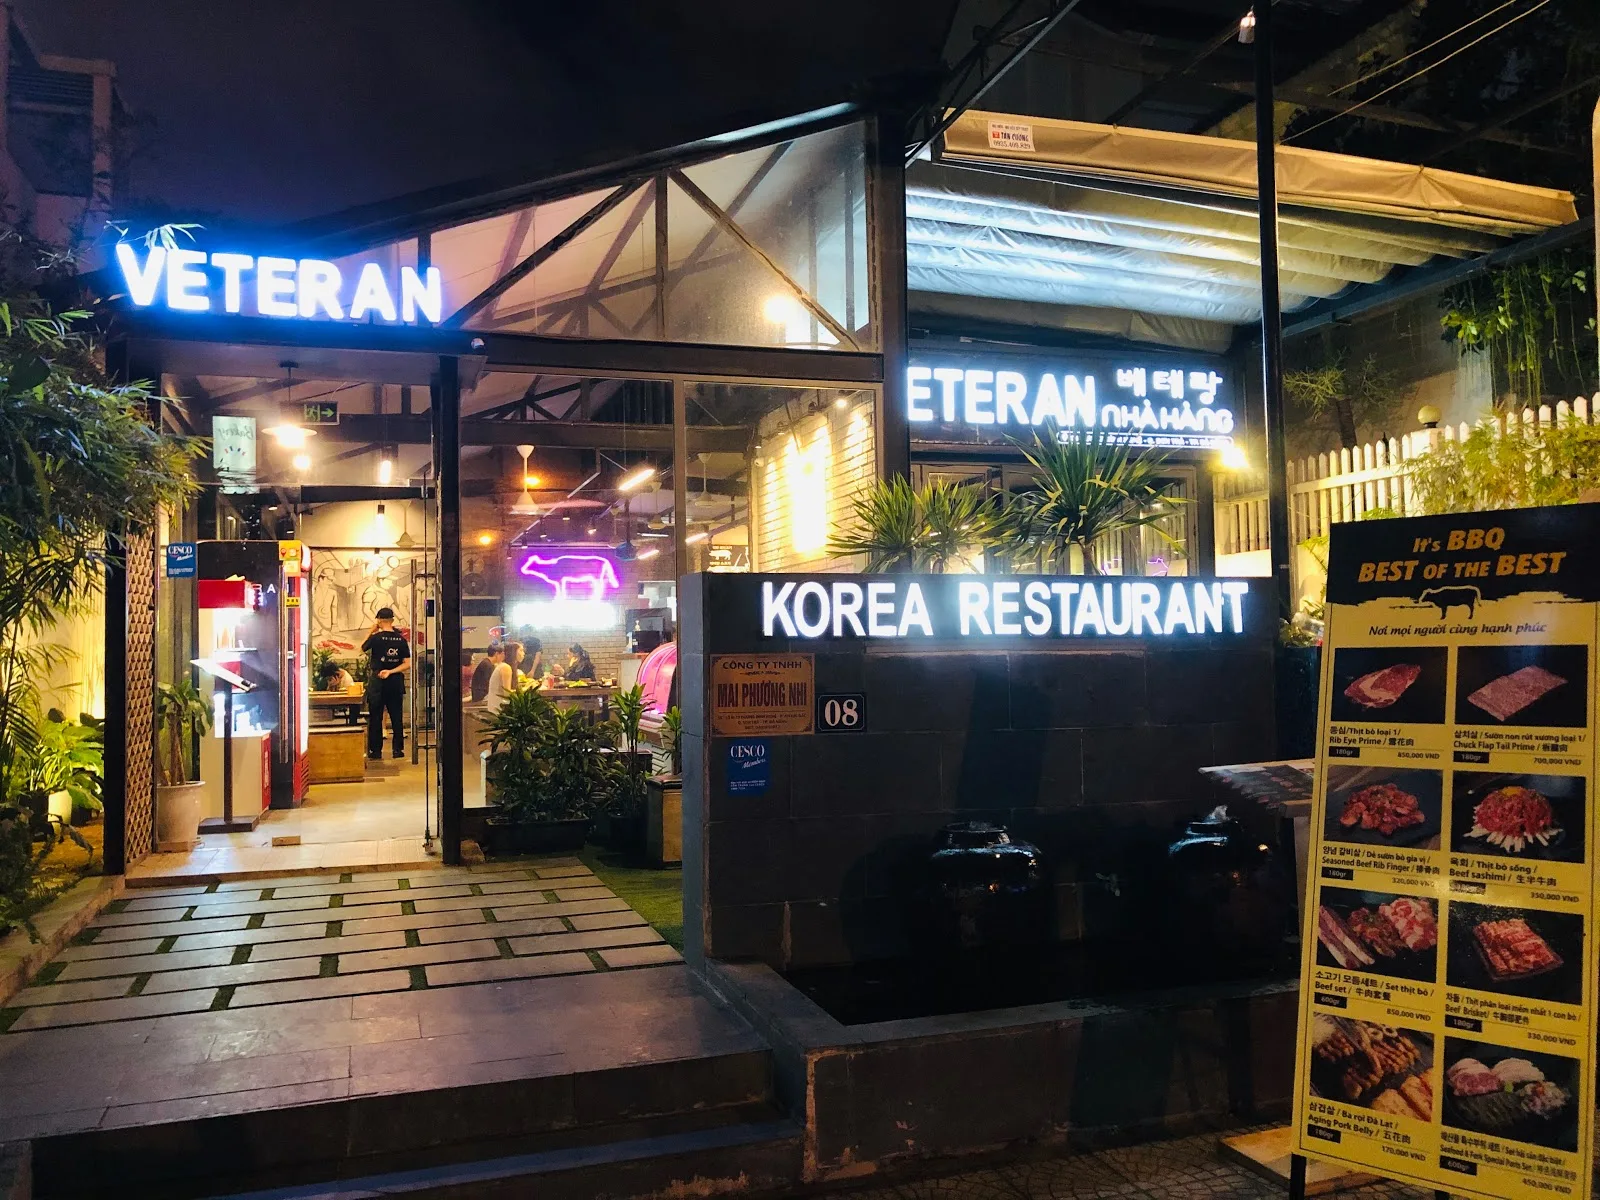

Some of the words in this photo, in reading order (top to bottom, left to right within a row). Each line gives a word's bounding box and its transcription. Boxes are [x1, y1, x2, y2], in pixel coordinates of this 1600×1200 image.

[115, 244, 441, 323] VETERAN
[906, 366, 1096, 426] ETERAN
[1413, 537, 1441, 553] It's
[1447, 527, 1505, 551] BBQ
[1358, 559, 1419, 583] BEST
[1423, 564, 1448, 580] OF
[1453, 561, 1490, 578] THE
[1496, 551, 1567, 576] BEST
[761, 581, 934, 638] KOREA
[958, 581, 1249, 636] RESTAURANT
[1369, 625, 1387, 636] Nơi
[1390, 626, 1412, 637] mọi
[1414, 624, 1447, 637] người
[1449, 625, 1478, 637] cùng
[1481, 623, 1512, 635] hạnh
[723, 660, 753, 670] CÔNG
[757, 661, 769, 669] TY
[772, 661, 802, 669] TNHH
[717, 683, 738, 708] MAI
[789, 682, 807, 706] NHI
[824, 699, 859, 727] 08
[1329, 736, 1341, 744] Rib
[1343, 736, 1356, 745] Eye
[1360, 737, 1382, 745] Prime
[1453, 741, 1476, 749] Chuck
[1478, 742, 1494, 750] Flap
[1512, 743, 1535, 751] Prime
[730, 744, 765, 758] CESCO
[1322, 857, 1354, 866] Seasoned
[1356, 858, 1372, 868] Beef
[1373, 860, 1385, 869] Rib
[1387, 862, 1409, 873] Finger
[1449, 868, 1470, 877] Beef
[1471, 870, 1506, 881] sashimi
[1562, 894, 1580, 903] VND
[1315, 971, 1341, 982] 소고기
[1385, 983, 1399, 991] Set
[1315, 981, 1333, 990] Beef
[1334, 985, 1347, 993] set
[1416, 1013, 1431, 1021] VND
[1559, 1036, 1576, 1046] VND
